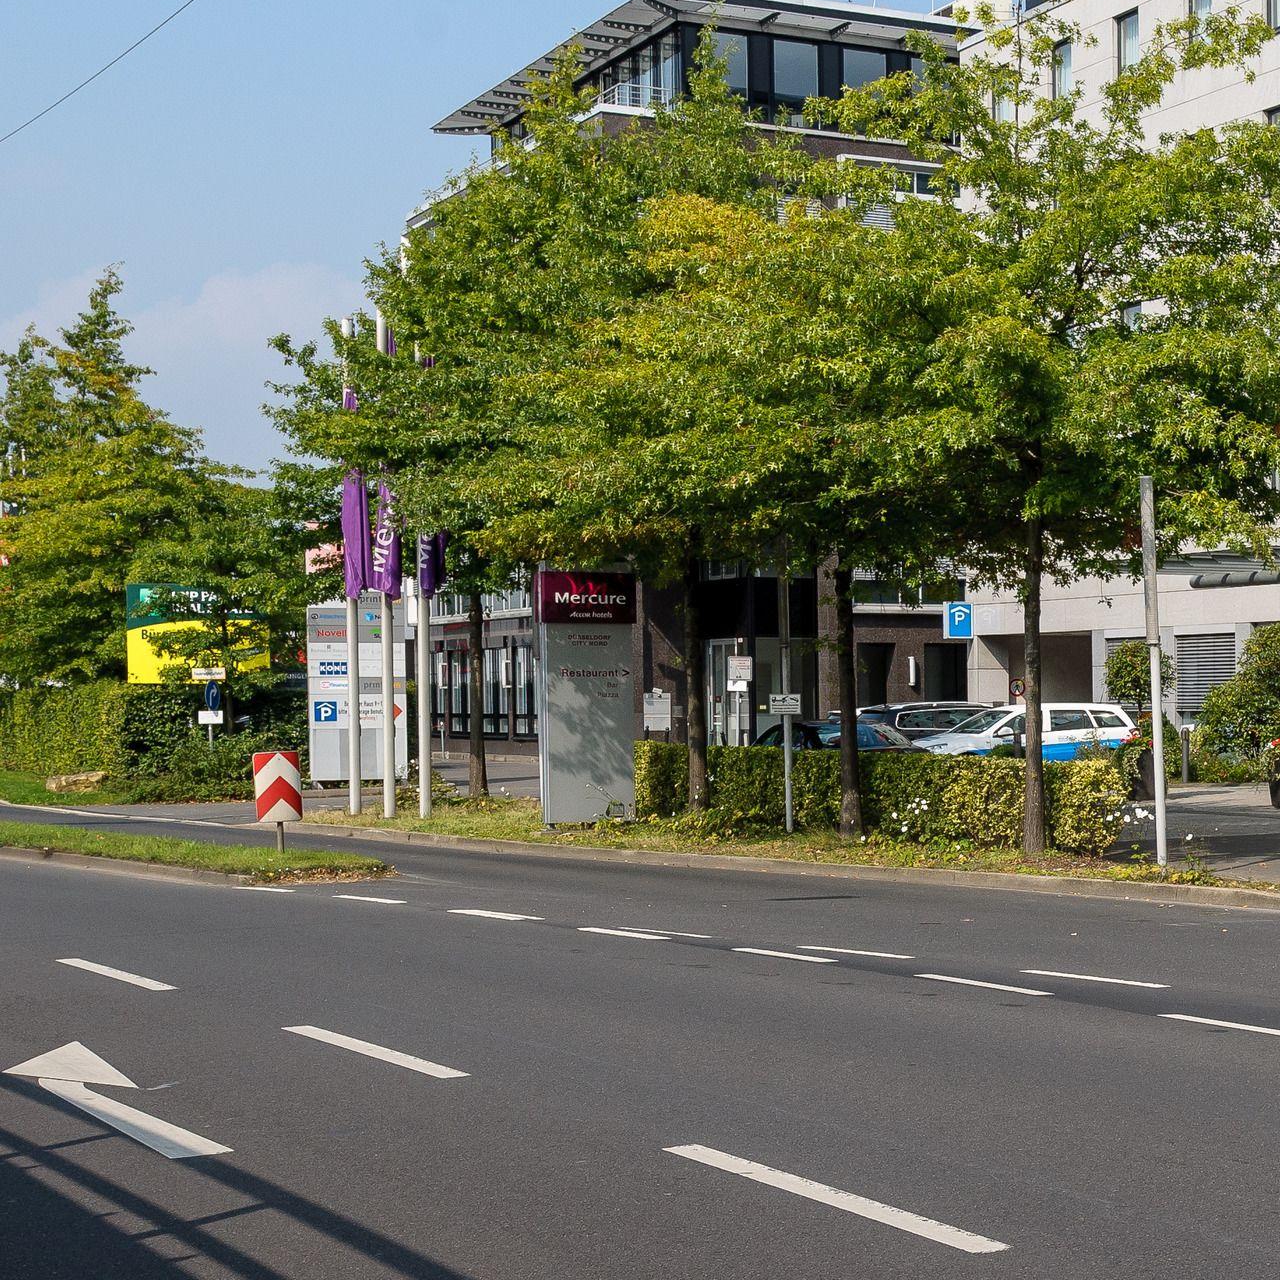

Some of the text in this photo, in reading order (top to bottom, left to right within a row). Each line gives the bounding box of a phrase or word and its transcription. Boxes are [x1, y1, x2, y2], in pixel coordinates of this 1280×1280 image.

[555, 592, 627, 605] Mercure
[592, 611, 613, 619] hotels
[955, 610, 965, 625] P
[320, 663, 347, 673] KONE
[561, 668, 619, 678] Restaurant
[606, 681, 619, 689] Bar
[321, 706, 332, 721] P
